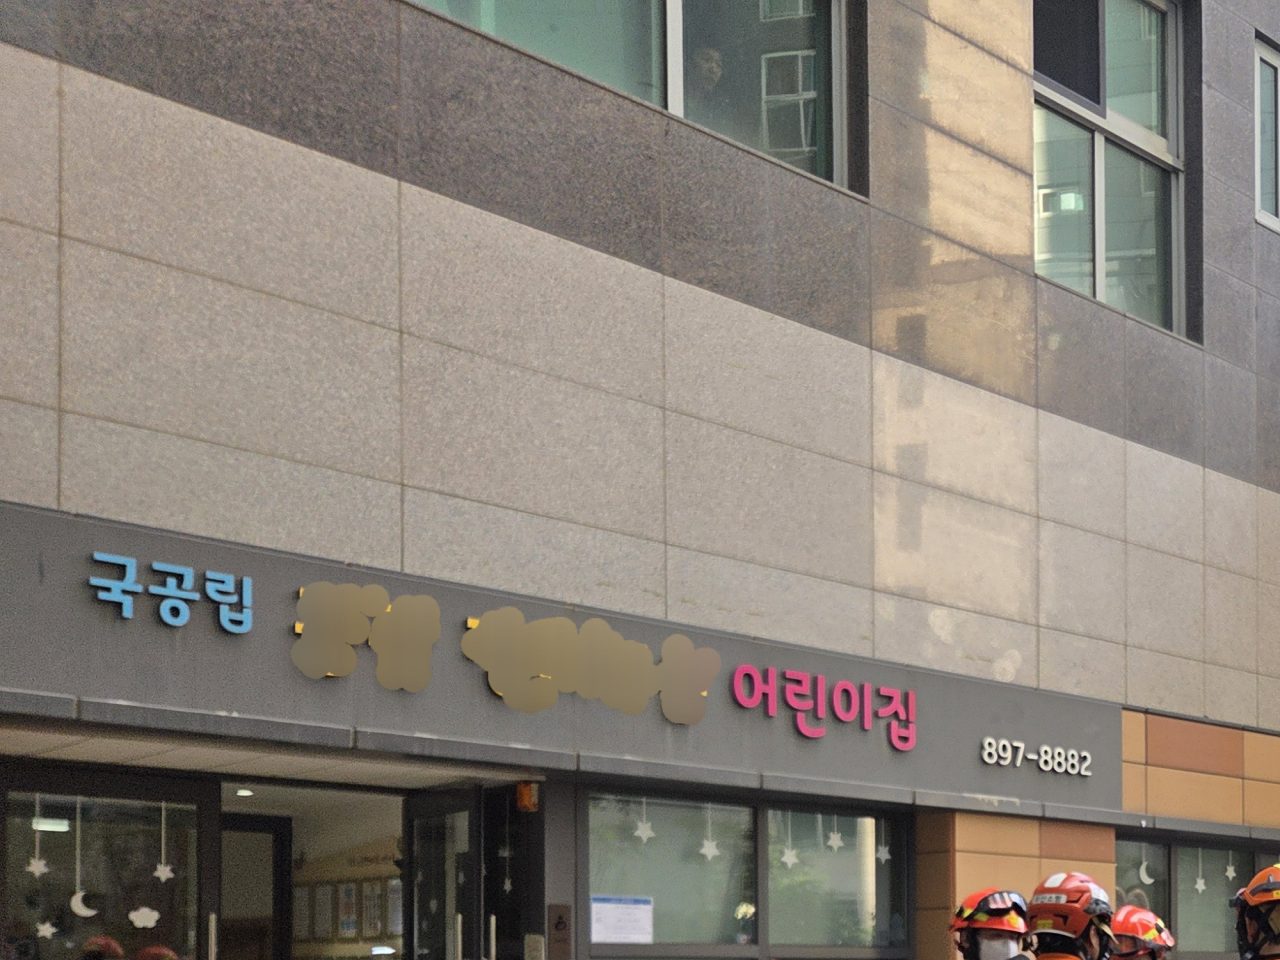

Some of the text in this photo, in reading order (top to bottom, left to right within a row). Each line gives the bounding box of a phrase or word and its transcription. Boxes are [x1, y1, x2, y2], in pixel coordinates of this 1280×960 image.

[88, 551, 253, 634] 국공립
[733, 663, 917, 751] 어린이집
[981, 736, 1092, 777] 897-8882
